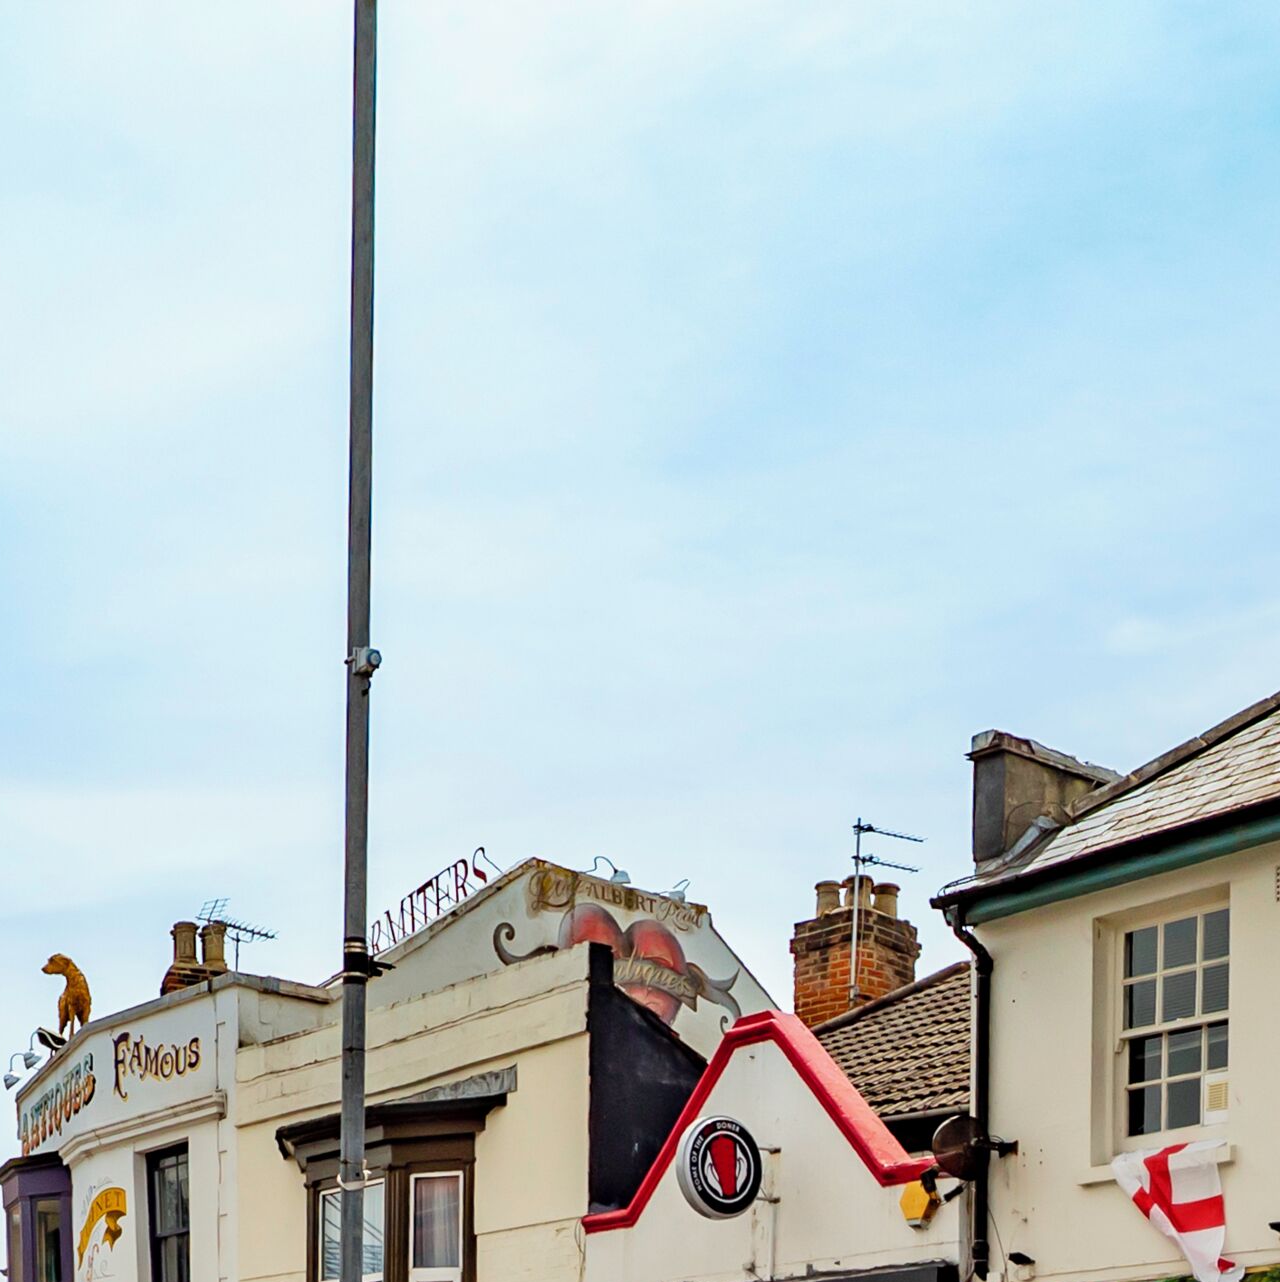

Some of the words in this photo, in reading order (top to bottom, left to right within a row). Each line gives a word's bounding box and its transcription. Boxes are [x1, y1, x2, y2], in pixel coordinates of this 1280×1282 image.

[588, 884, 657, 914] ALBERT
[112, 1031, 201, 1102] FAMOUS
[715, 1121, 741, 1133] DONER
[694, 1135, 705, 1149] THE
[691, 1151, 698, 1163] OF
[691, 1165, 703, 1192] HOME
